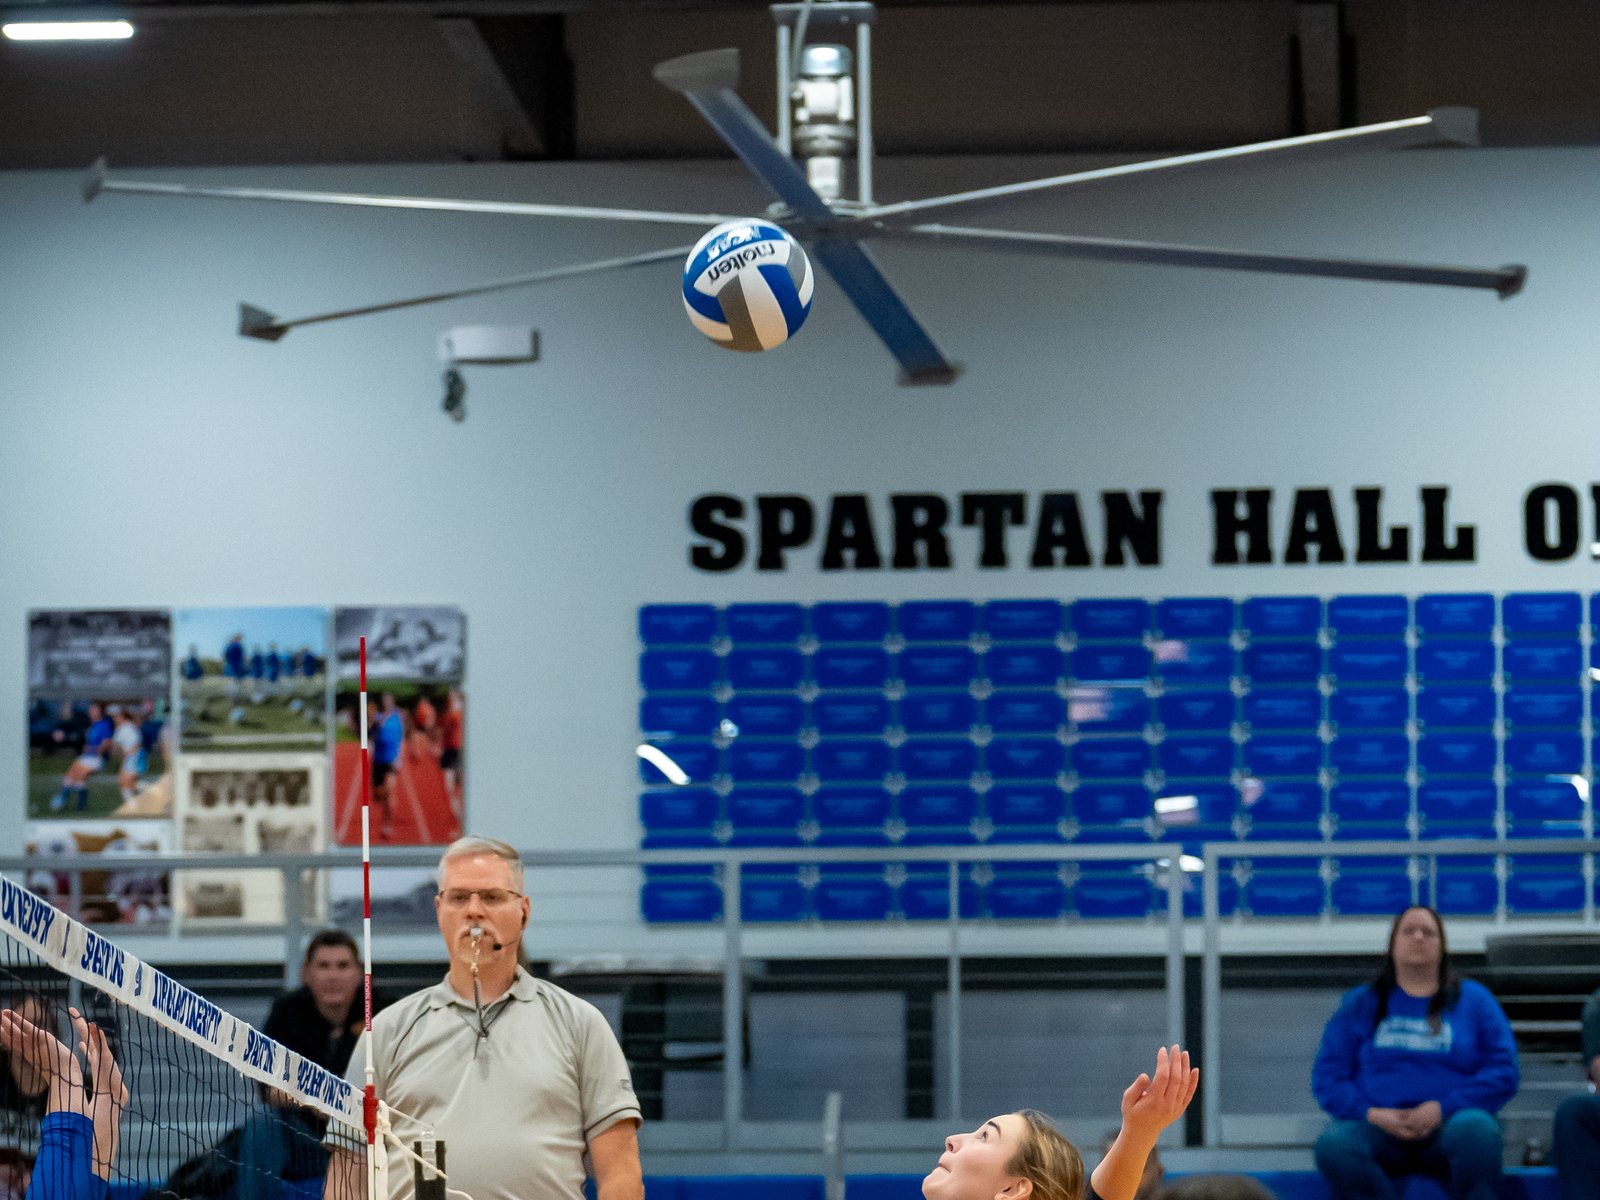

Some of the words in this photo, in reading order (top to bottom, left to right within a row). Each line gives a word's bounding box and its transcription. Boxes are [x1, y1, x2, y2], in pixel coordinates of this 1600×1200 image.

[707, 242, 776, 283] molten
[689, 491, 1164, 573] SPARTAN
[1209, 484, 1477, 566] HALL
[1523, 480, 1600, 564] O
